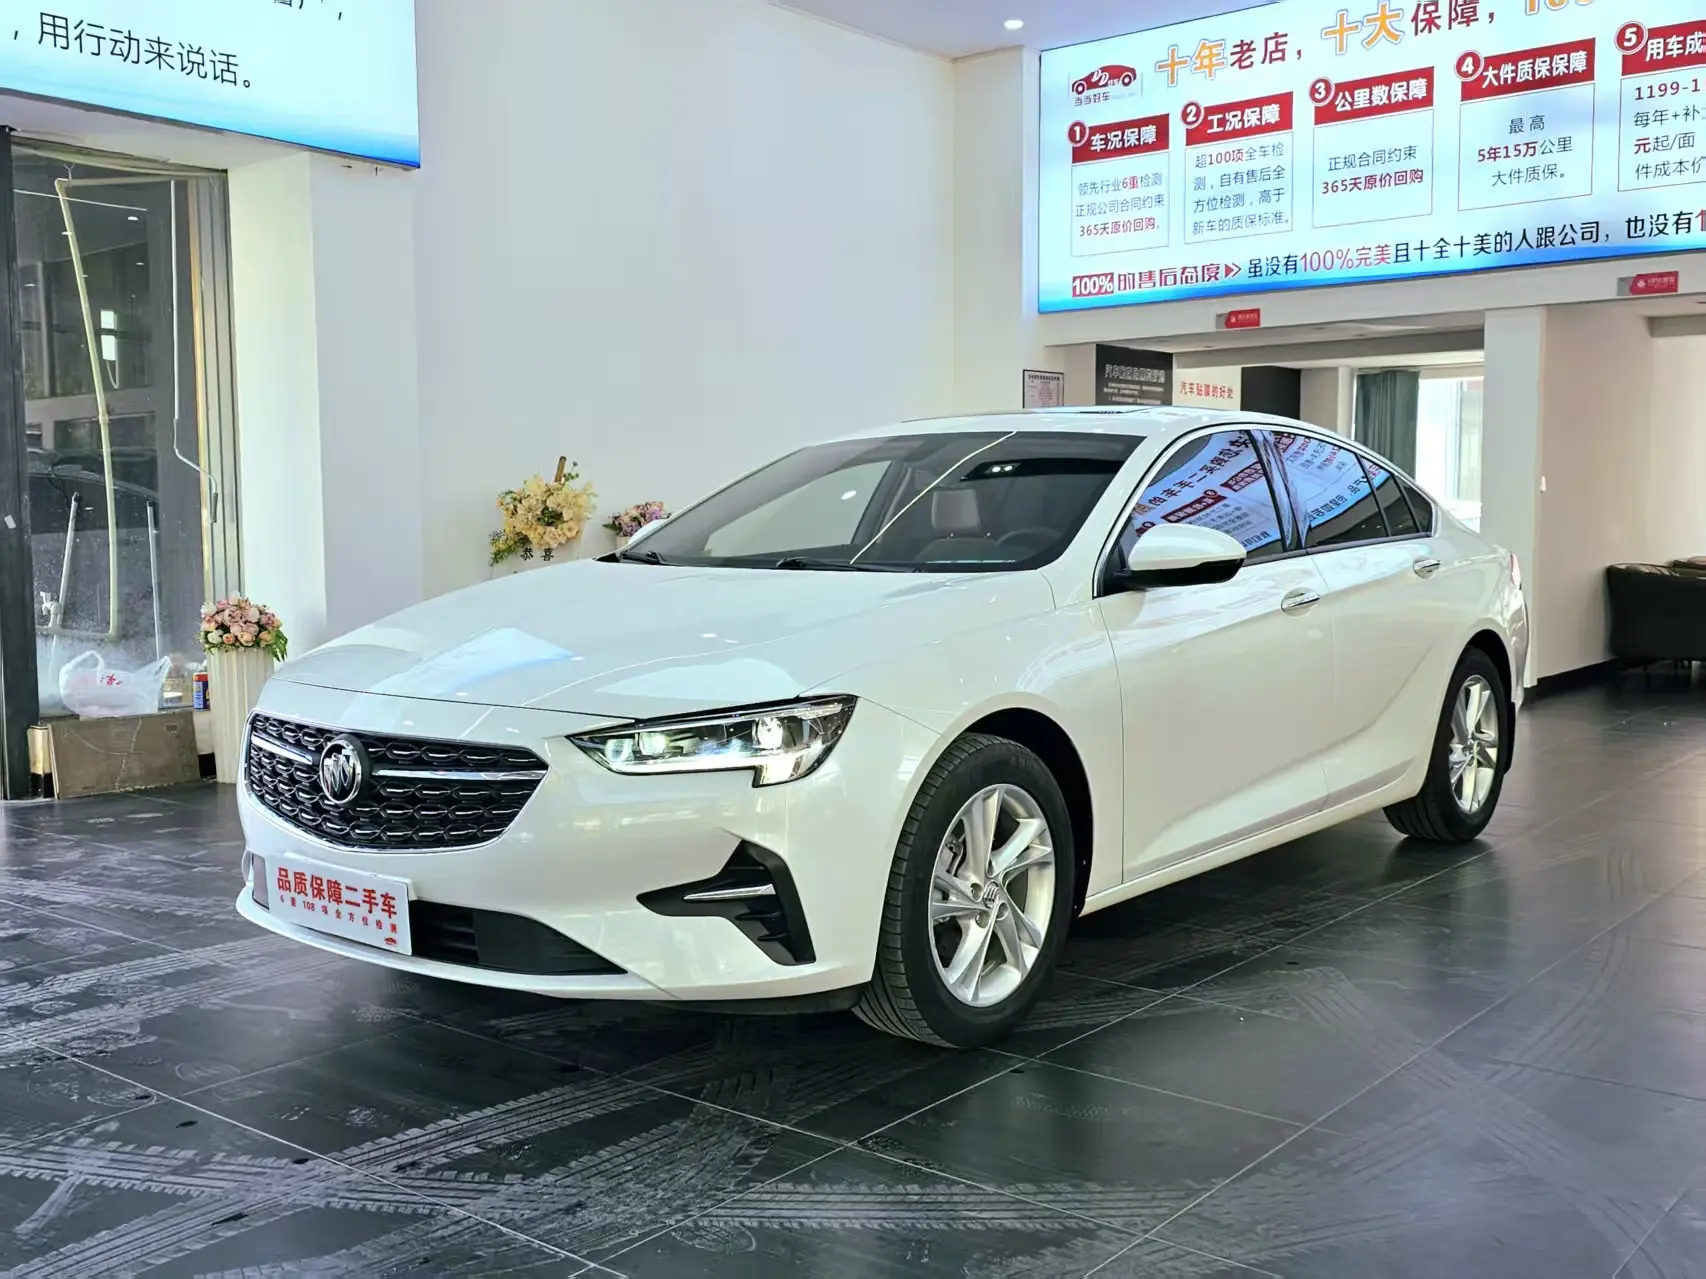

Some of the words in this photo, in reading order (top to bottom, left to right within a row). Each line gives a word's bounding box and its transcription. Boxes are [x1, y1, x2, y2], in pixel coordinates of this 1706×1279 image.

[1645, 32, 1706, 61] 用车成
[1482, 50, 1588, 89] 大件质保保障
[1335, 78, 1427, 112] 公里数保障
[1634, 78, 1706, 101] 1199-1
[1207, 104, 1281, 134] 工况保障
[1508, 114, 1546, 135] 最高
[1633, 104, 1706, 128] 每年+补
[1090, 125, 1157, 152] 车况保障
[1477, 136, 1573, 163] 5年15万公里
[1195, 142, 1284, 168] 超100项全车检
[1328, 145, 1418, 172] 正规合同约束
[1322, 168, 1424, 194] 365天原价回购
[1075, 194, 1165, 217] 正规公司合同约束
[520, 547, 555, 562] 恭喜
[277, 867, 397, 919] 品质保障二手车
